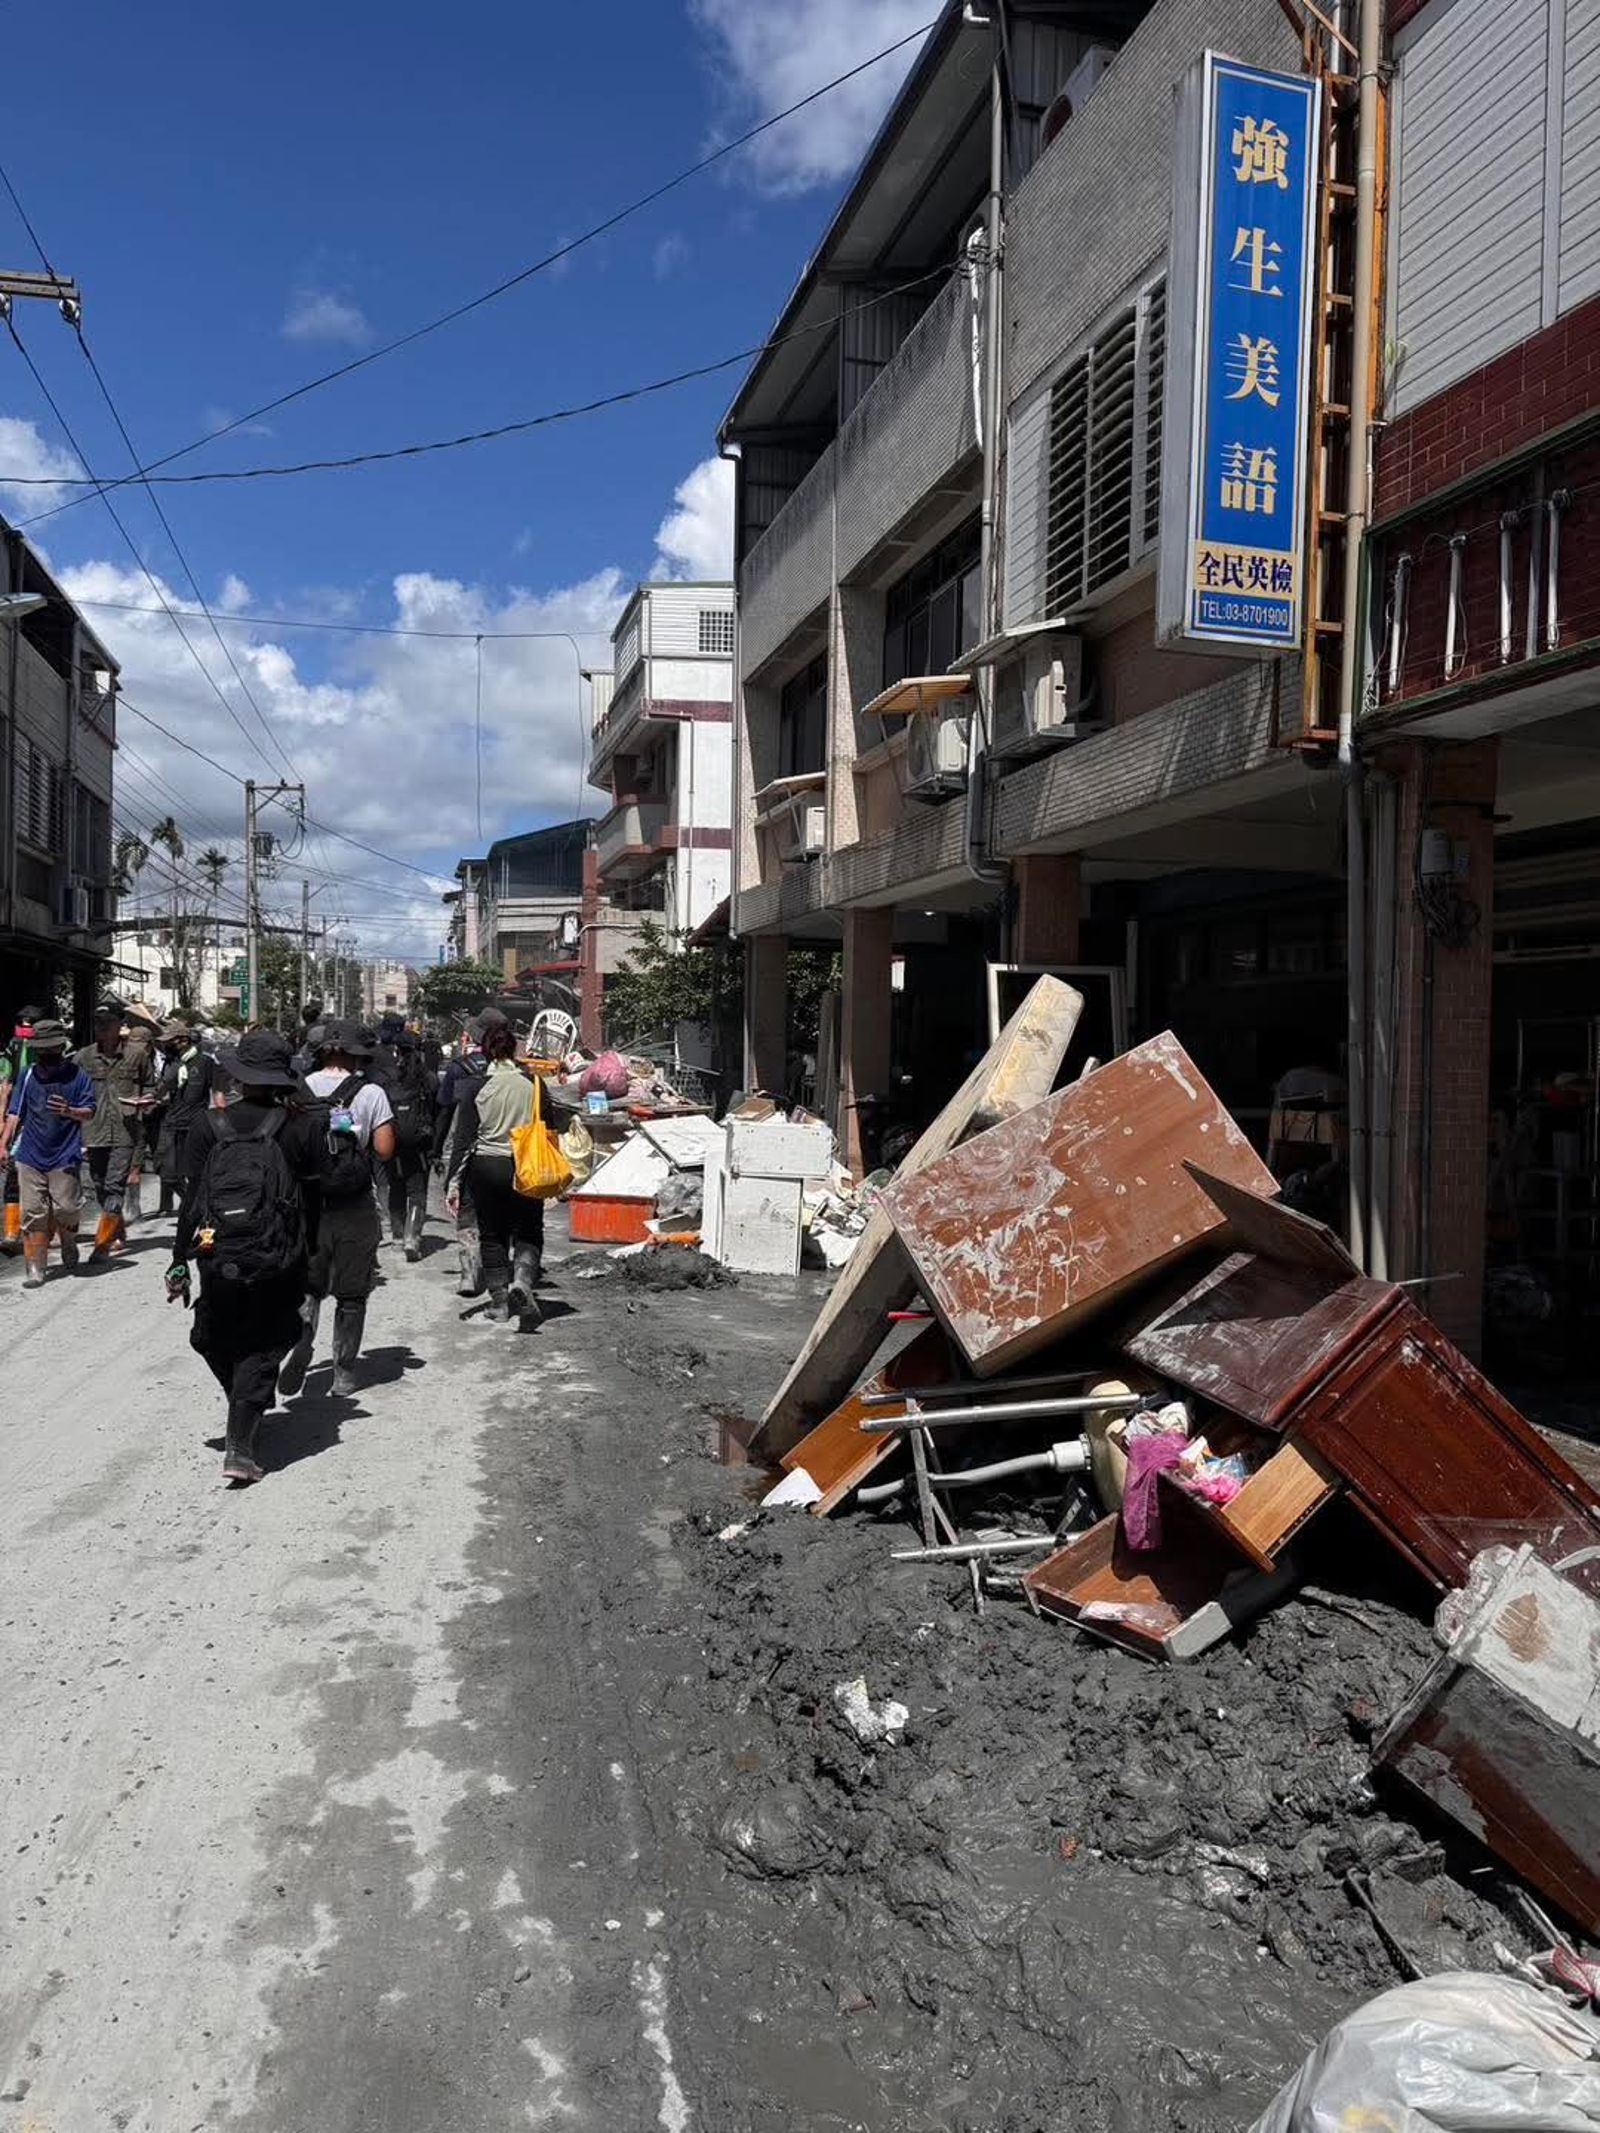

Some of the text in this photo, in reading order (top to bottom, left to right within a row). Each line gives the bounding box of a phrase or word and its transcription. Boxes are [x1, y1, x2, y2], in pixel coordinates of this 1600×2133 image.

[1220, 115, 1290, 515] 強生美語
[1198, 550, 1293, 593] 全民英檢
